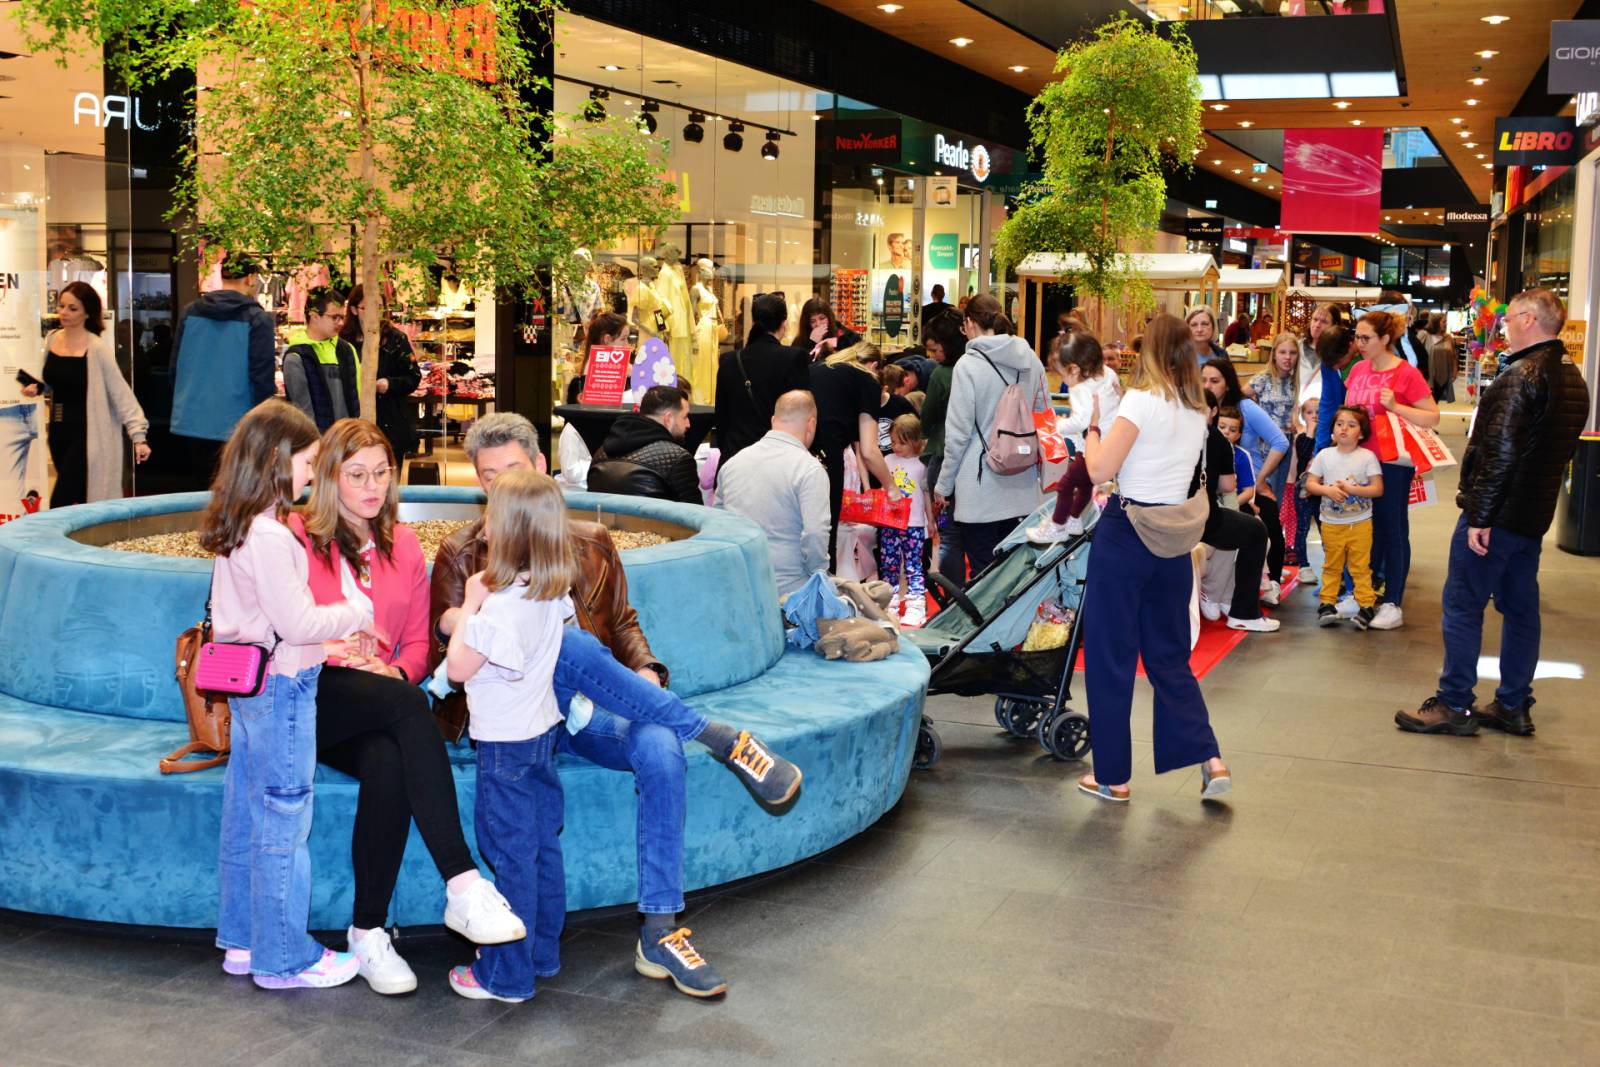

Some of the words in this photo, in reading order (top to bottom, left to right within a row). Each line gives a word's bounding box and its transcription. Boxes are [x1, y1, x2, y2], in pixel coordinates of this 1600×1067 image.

[934, 133, 969, 170] Pearle
[1447, 211, 1488, 221] Modessa
[1351, 373, 1394, 390] KICK
